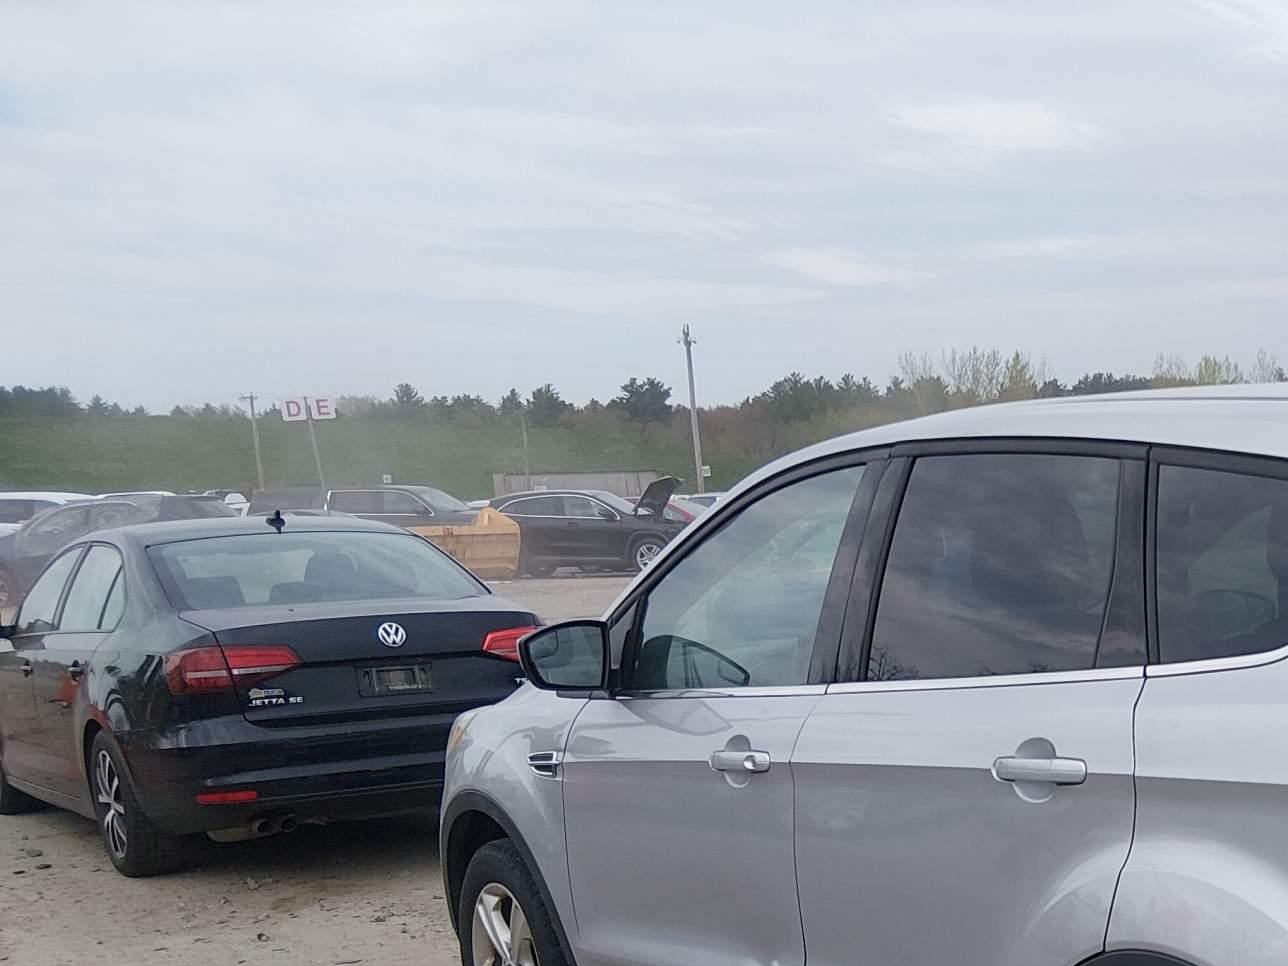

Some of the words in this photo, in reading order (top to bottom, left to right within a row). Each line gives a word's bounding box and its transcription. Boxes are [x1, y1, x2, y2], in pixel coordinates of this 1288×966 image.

[285, 400, 302, 417] D
[315, 399, 331, 416] E
[248, 698, 285, 707] JETTA
[288, 696, 304, 704] SE
